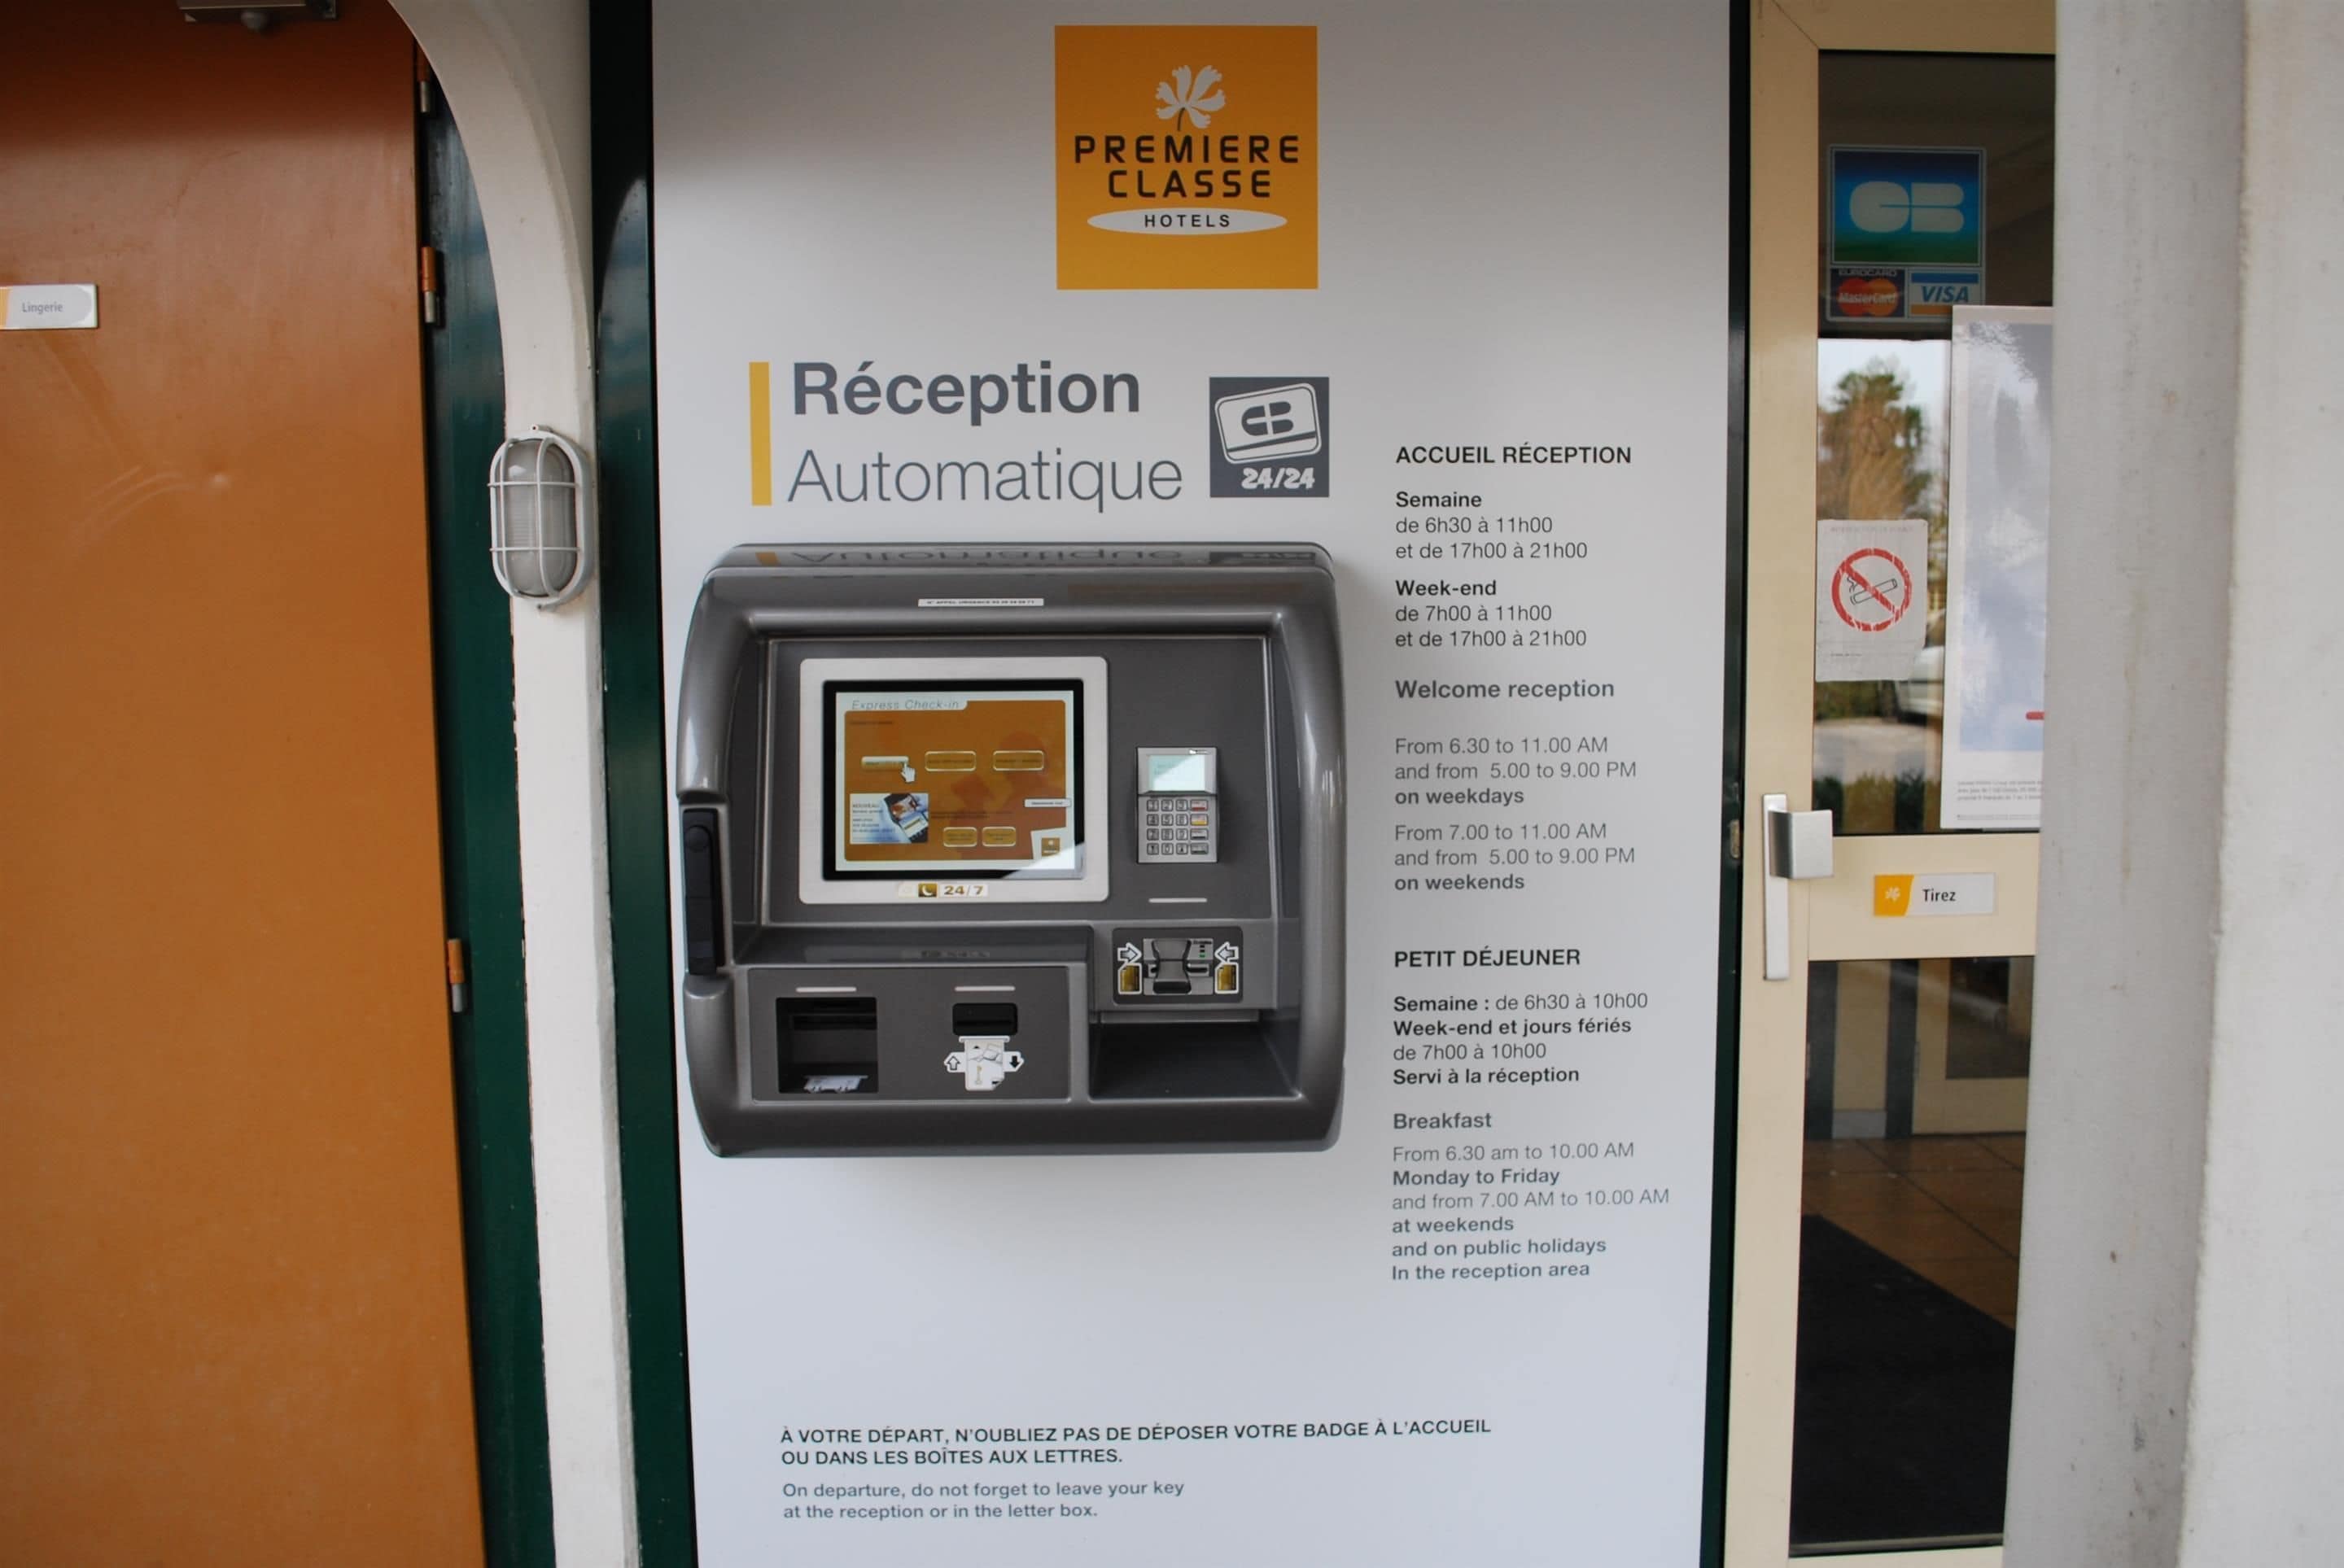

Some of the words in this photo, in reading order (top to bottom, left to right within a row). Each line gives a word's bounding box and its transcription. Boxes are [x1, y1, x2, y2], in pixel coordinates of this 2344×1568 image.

[1075, 135, 1298, 163] PREMIERE
[1109, 170, 1270, 198] CLASSE
[1849, 181, 1964, 233] CB
[1145, 215, 1230, 227] HOTELS
[1838, 293, 1896, 304] MasterCard
[1922, 286, 1969, 303] VISA
[22, 302, 63, 314] Lingerie
[794, 360, 1139, 426] Réception
[1241, 401, 1293, 436] CB
[1396, 446, 1495, 463] ACCUEIL
[1503, 443, 1630, 463] RÉCEPTION
[788, 448, 1182, 513] Automatique
[1241, 467, 1315, 489] 24/24
[1396, 491, 1481, 507] Semaine
[1396, 518, 1419, 533] de
[1426, 517, 1471, 533] 6h30
[1478, 517, 1489, 533] à
[1498, 517, 1552, 533] 11h00
[1396, 544, 1413, 558] et
[1419, 543, 1442, 558] de
[1450, 543, 1507, 558] 17h00
[1513, 542, 1524, 558] à
[1530, 543, 1587, 558] 21h00
[1396, 580, 1496, 596] Week-end
[1395, 605, 1419, 622] de
[1426, 605, 1471, 622] 7h00
[1478, 605, 1488, 621] à
[1496, 605, 1551, 621] 11h00
[1396, 631, 1413, 647] et
[1419, 631, 1442, 647] de
[1450, 631, 1506, 646] 17h00
[1513, 630, 1524, 646] à
[1530, 630, 1586, 646] 21h00
[1395, 679, 1500, 698] Welcome
[1509, 679, 1614, 701] reception
[851, 699, 900, 710] Express
[905, 699, 960, 710] Check-in
[1396, 738, 1442, 754] From
[1450, 738, 1489, 754] 6.30
[1496, 739, 1513, 753] to
[1521, 737, 1571, 753] 11.00
[1577, 737, 1607, 753] AM
[1395, 763, 1429, 780] and
[1436, 762, 1477, 779] from
[1491, 762, 1529, 779] 5.00
[1537, 763, 1554, 778] to
[1560, 762, 1599, 778] 9.00
[1607, 762, 1636, 777] PM
[1395, 793, 1419, 804] on
[1426, 788, 1524, 806] weekdays
[1396, 825, 1442, 841] From
[1450, 824, 1489, 840] 7.00
[1495, 824, 1512, 840] to
[1520, 823, 1569, 840] 11.00
[1576, 823, 1606, 838] AM
[1395, 850, 1428, 866] and
[1436, 849, 1476, 865] from
[1489, 849, 1528, 865] 5.00
[1535, 850, 1553, 864] to
[1559, 848, 1598, 864] 9.00
[1606, 848, 1634, 863] PM
[1395, 879, 1418, 890] on
[1425, 874, 1524, 890] weekends
[1923, 889, 1955, 902] Tirez
[1395, 950, 1456, 967] PETIT
[1463, 946, 1580, 967] DÉJEUNER
[1393, 996, 1477, 1011] Semaine
[1485, 999, 1489, 1011] :
[1496, 995, 1518, 1010] de
[1524, 994, 1569, 1010] 6h30
[1576, 994, 1585, 1009] à
[1594, 993, 1647, 1009] 10h00
[1393, 1020, 1492, 1036] Week-end
[1499, 1020, 1517, 1034] et
[1523, 1019, 1571, 1037] jours
[1578, 1018, 1631, 1033] fériés
[1393, 1045, 1416, 1060] de
[1423, 1044, 1467, 1059] 7h00
[1474, 1044, 1484, 1059] à
[1492, 1043, 1546, 1059] 10h00
[1393, 1068, 1441, 1085] Servi
[1448, 1068, 1458, 1084] à
[1466, 1068, 1481, 1083] la
[1489, 1068, 1579, 1085] réception
[1393, 1112, 1491, 1129] Breakfast
[1393, 1147, 1439, 1162] From
[1445, 1146, 1485, 1161] 6.30
[1491, 1148, 1518, 1160] am
[1525, 1146, 1542, 1159] to
[1550, 1143, 1598, 1159] 10.00
[1604, 1142, 1633, 1157] AM
[1393, 1170, 1469, 1187] Monday
[1476, 1170, 1494, 1184] to
[1502, 1168, 1559, 1186] Friday
[1393, 1194, 1425, 1209] and
[1432, 1193, 1472, 1208] from
[1480, 1192, 1518, 1208] 7.00
[1524, 1191, 1554, 1206] AM
[1561, 1192, 1578, 1206] to
[1585, 1190, 1633, 1205] 10.00
[1639, 1188, 1668, 1203] AM
[1393, 1219, 1410, 1233] at
[1416, 1216, 1514, 1232] weekends
[1393, 1242, 1427, 1256] and
[1434, 1244, 1457, 1256] on
[1464, 1240, 1520, 1258] public
[1528, 1238, 1606, 1256] holidays
[1393, 1266, 1408, 1280] In
[1415, 1265, 1445, 1279] the
[1452, 1263, 1542, 1281] reception
[1549, 1264, 1589, 1276] area
[781, 1426, 793, 1443] À
[798, 1430, 861, 1443] VOTRE
[868, 1426, 949, 1447] DÉPART,
[956, 1428, 1056, 1442] N'OUBLIEZ
[1064, 1427, 1100, 1441] PAS
[1107, 1427, 1131, 1440] DE
[1139, 1423, 1227, 1440] DÉPOSER
[1235, 1424, 1297, 1438] VOTRE
[1304, 1422, 1368, 1437] BADGE
[1375, 1419, 1386, 1435] À
[1393, 1419, 1491, 1435] L'ACCUEIL
[781, 1452, 808, 1465] OU
[816, 1451, 868, 1465] DANS
[874, 1451, 908, 1464] LES
[915, 1448, 982, 1464] BOÎTES
[990, 1450, 1027, 1463] AUX
[1034, 1449, 1122, 1463] LETTRES.
[783, 1483, 807, 1496] On
[814, 1484, 905, 1500] departure,
[912, 1484, 934, 1496] do
[940, 1484, 968, 1496] not
[974, 1483, 1027, 1499] forget
[1033, 1483, 1050, 1496] to
[1056, 1483, 1102, 1496] leave
[1109, 1484, 1148, 1497] your
[1154, 1481, 1184, 1496] key
[784, 1506, 801, 1518] at
[806, 1505, 833, 1518] the
[840, 1505, 923, 1521] reception
[929, 1508, 947, 1518] or
[954, 1505, 969, 1517] in
[975, 1505, 1002, 1517] the
[1009, 1504, 1055, 1517] letter
[1060, 1504, 1097, 1517] box.
